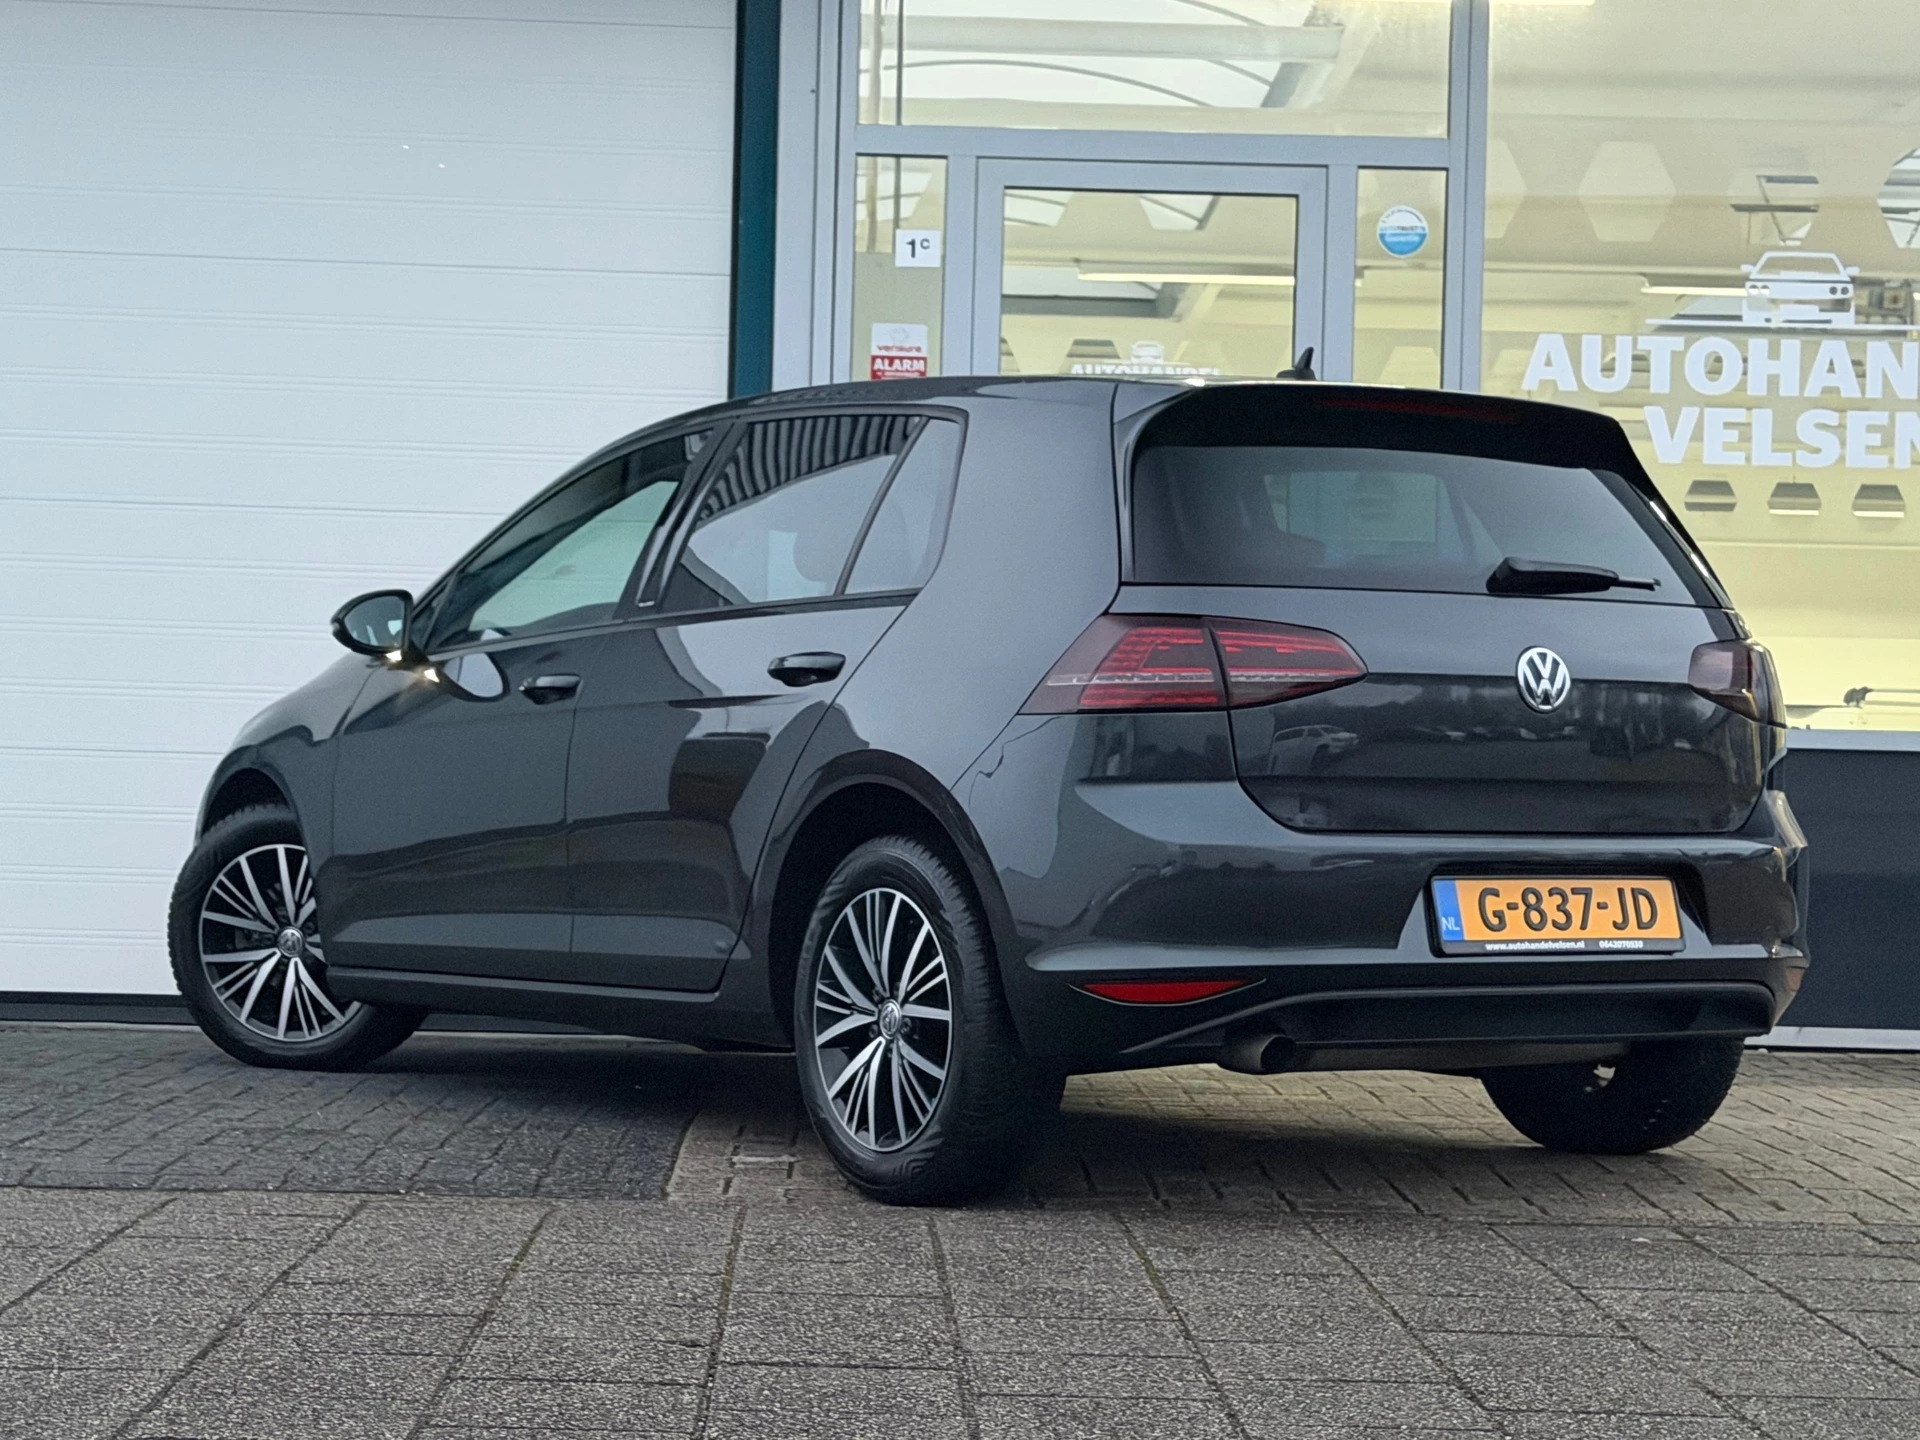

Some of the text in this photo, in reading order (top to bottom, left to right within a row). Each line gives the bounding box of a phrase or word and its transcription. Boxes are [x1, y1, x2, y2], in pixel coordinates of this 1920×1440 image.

[873, 358, 926, 372] ALARM
[1521, 333, 1919, 399] AUTOHAN
[1442, 917, 1461, 931] NL
[1478, 887, 1658, 932] G-837-JD
